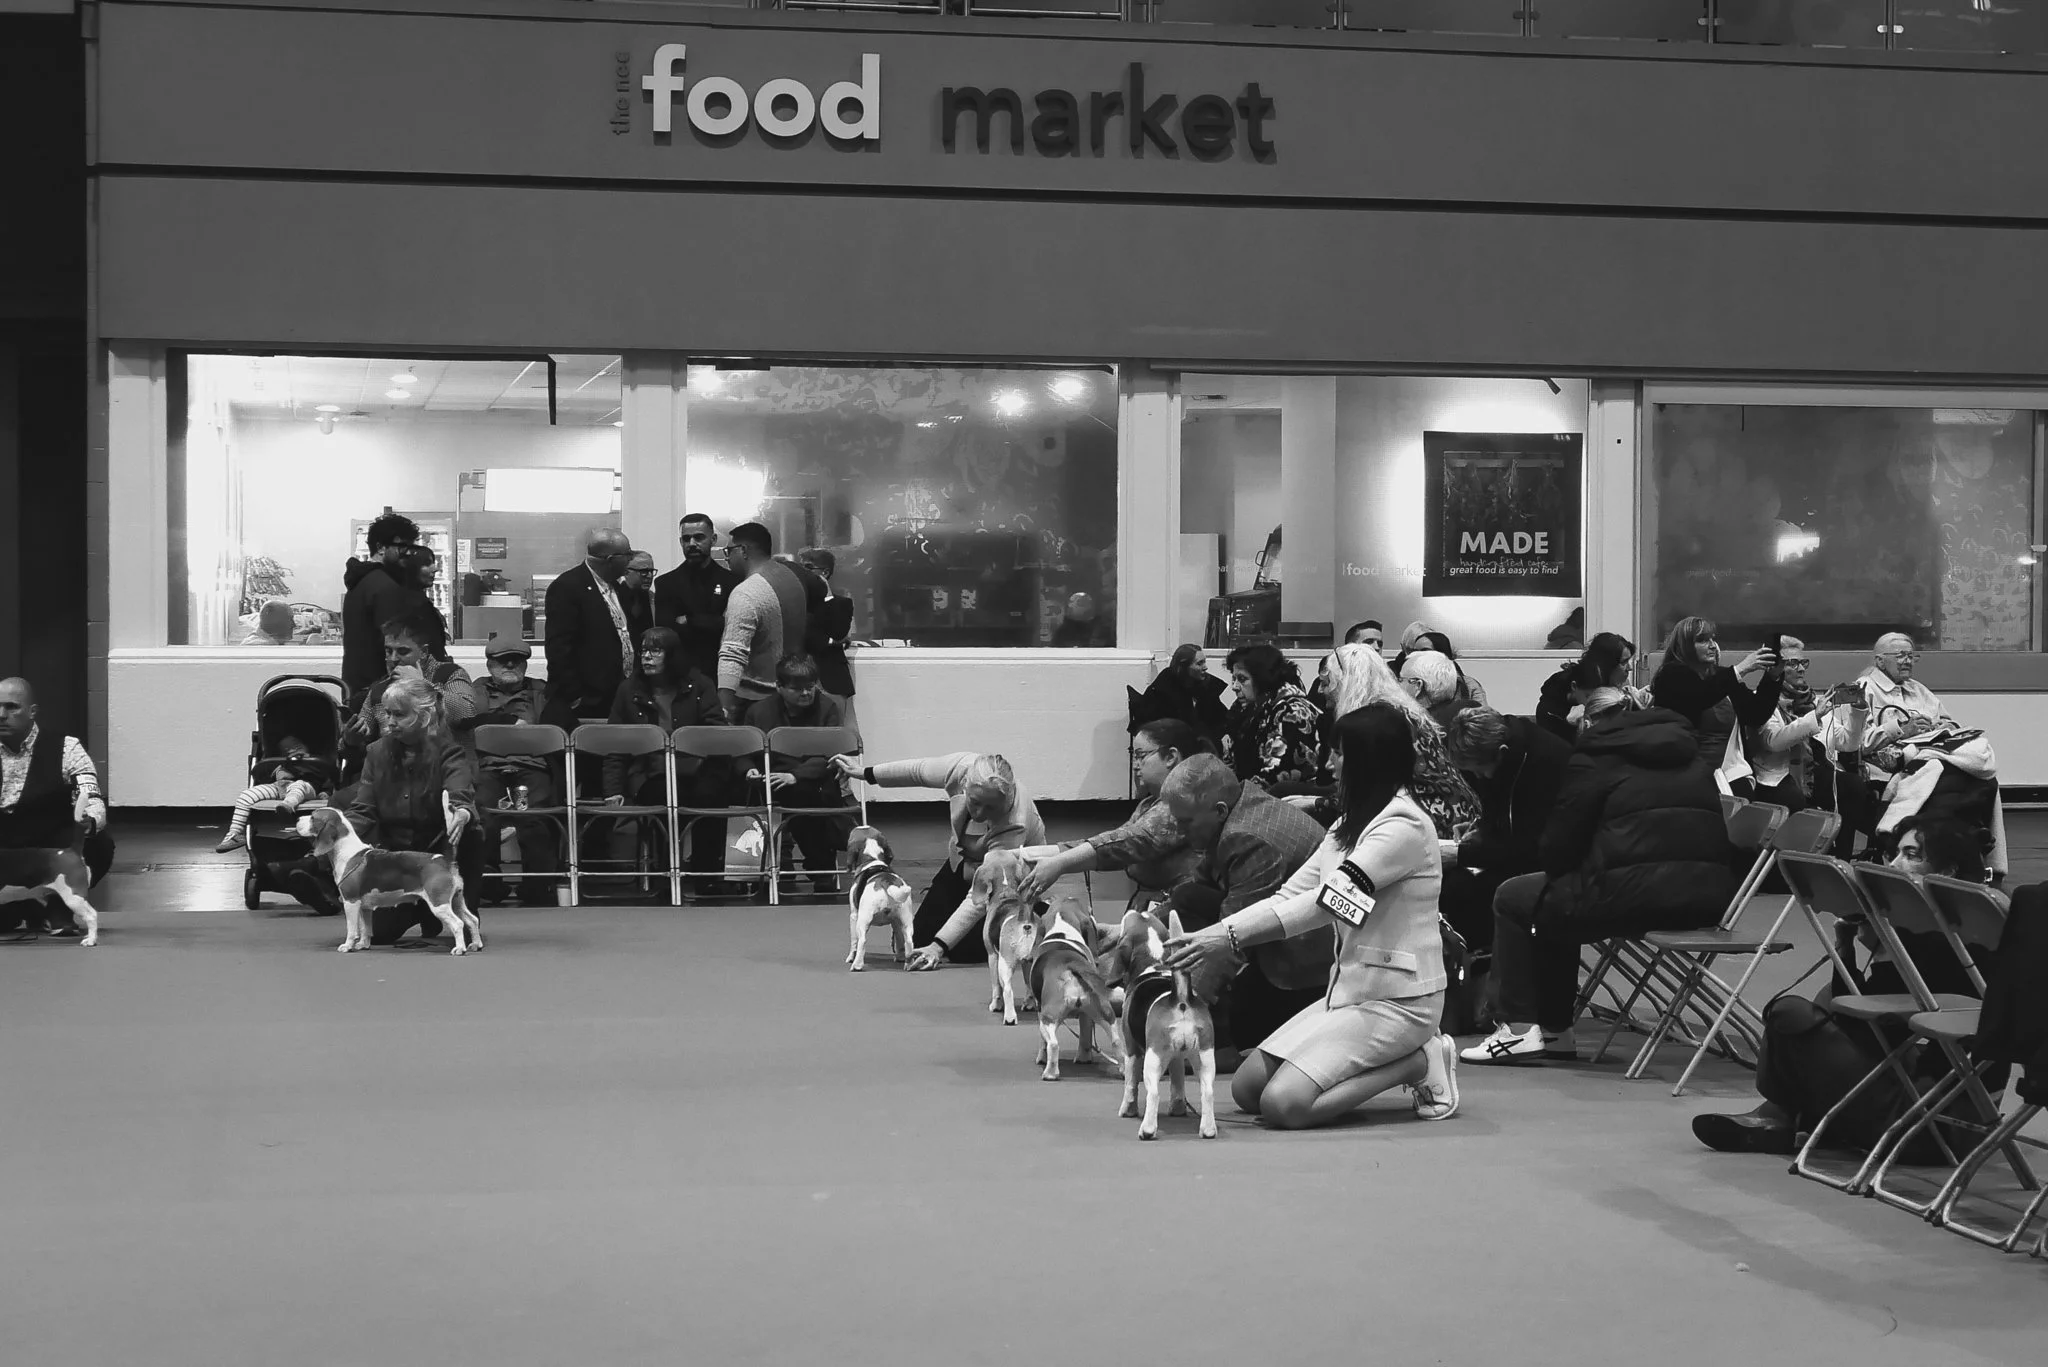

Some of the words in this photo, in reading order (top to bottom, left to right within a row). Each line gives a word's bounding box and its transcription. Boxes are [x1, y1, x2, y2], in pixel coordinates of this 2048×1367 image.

[642, 43, 881, 141] food
[941, 61, 1277, 165] market
[609, 97, 630, 136] the
[1460, 531, 1549, 554] MADE
[1382, 563, 1427, 577] arke
[1449, 566, 1474, 576] great
[1475, 564, 1496, 575] food
[1498, 565, 1506, 574] is
[1507, 566, 1528, 577] easy
[1529, 566, 1540, 575] to
[1541, 564, 1559, 575] find
[1330, 895, 1357, 919] 6994
